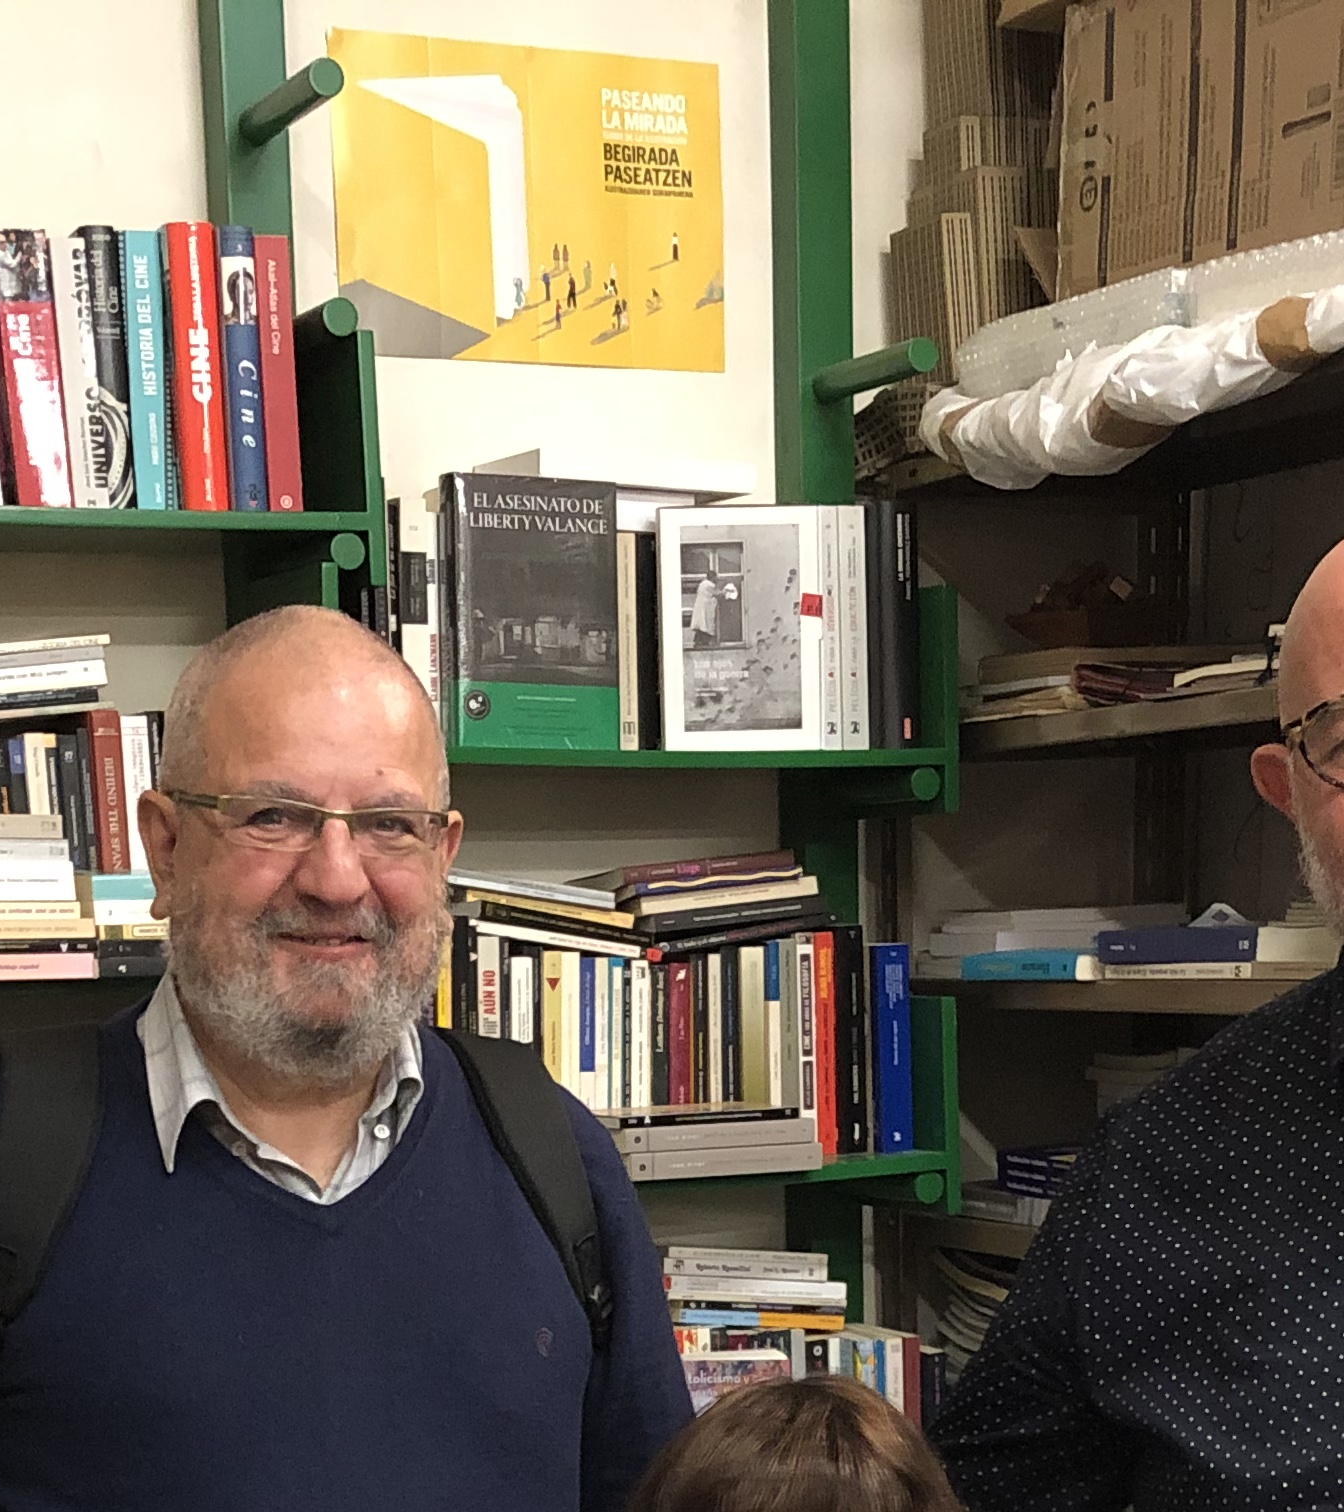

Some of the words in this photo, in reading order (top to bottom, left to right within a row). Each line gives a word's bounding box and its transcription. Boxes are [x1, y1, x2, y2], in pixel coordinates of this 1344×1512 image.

[601, 87, 686, 114] PASEANDO
[601, 109, 622, 130] LA
[624, 111, 688, 135] MIRADA
[603, 142, 680, 167] BEGIRADA
[604, 163, 693, 188] PASEATZEN
[90, 250, 104, 270] del
[132, 254, 149, 290] CINE
[91, 272, 107, 313] Historia
[107, 286, 120, 313] Cine
[135, 293, 152, 325] DEL
[135, 328, 157, 397] HISTORIA
[189, 328, 212, 403] CINE
[84, 386, 109, 489] UNIVERSO
[472, 491, 490, 508] EL
[486, 494, 580, 514] ASESINATO
[581, 498, 604, 515] DE
[468, 511, 533, 531] LIBERTY
[534, 515, 608, 535] VALANCE
[103, 756, 116, 801] BEHIND
[108, 808, 118, 834] THE
[482, 970, 496, 987] NO
[481, 990, 497, 1016] AÚN
